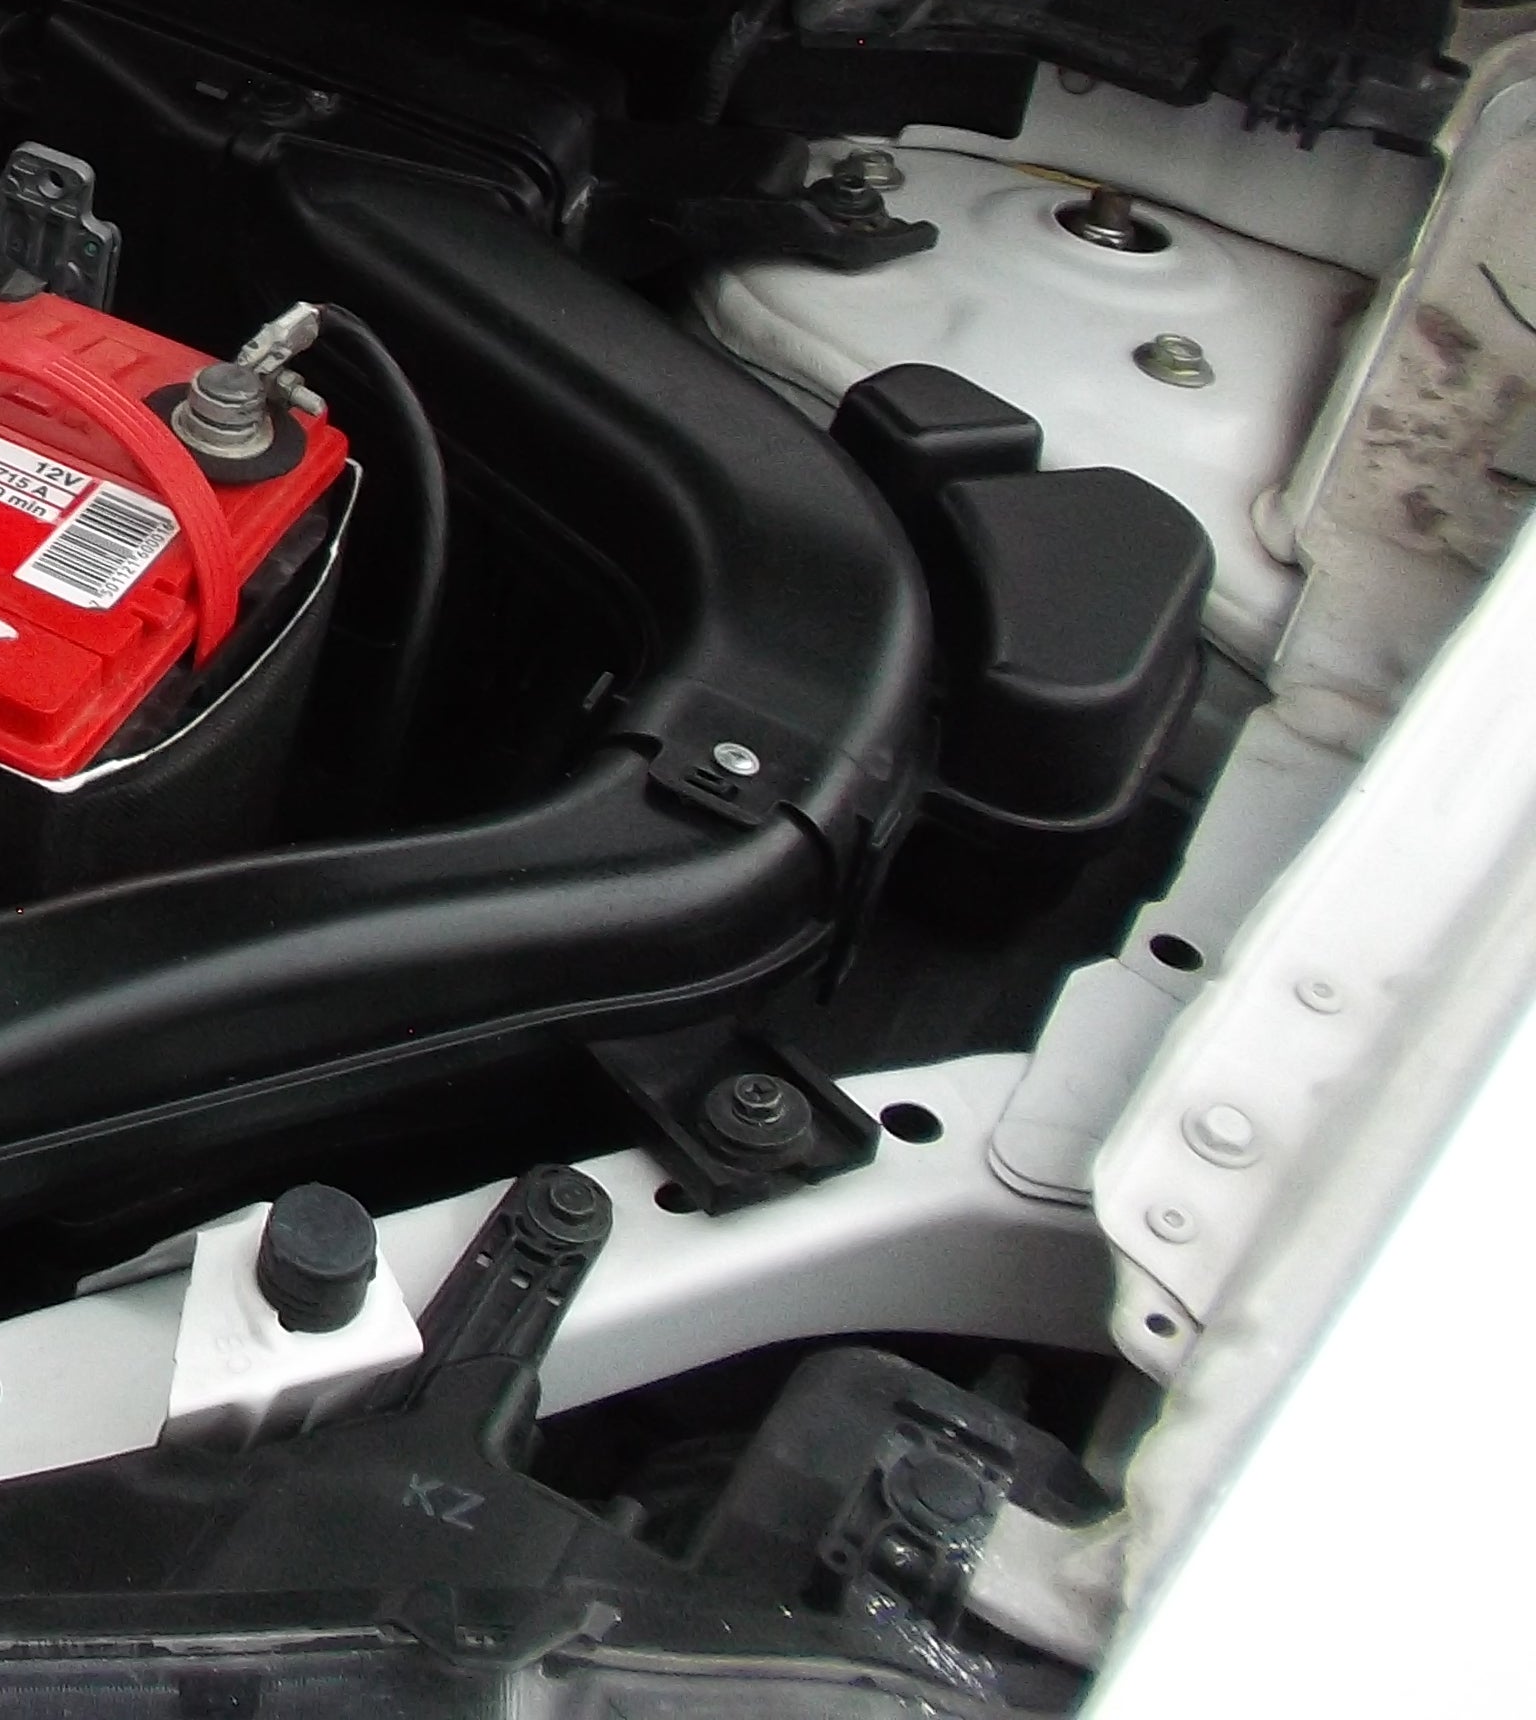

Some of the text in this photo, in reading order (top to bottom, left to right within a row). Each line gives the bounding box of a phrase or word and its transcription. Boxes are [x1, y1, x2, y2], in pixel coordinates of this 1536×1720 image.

[35, 461, 85, 487] 12V
[31, 484, 48, 498] A
[8, 494, 47, 518] min
